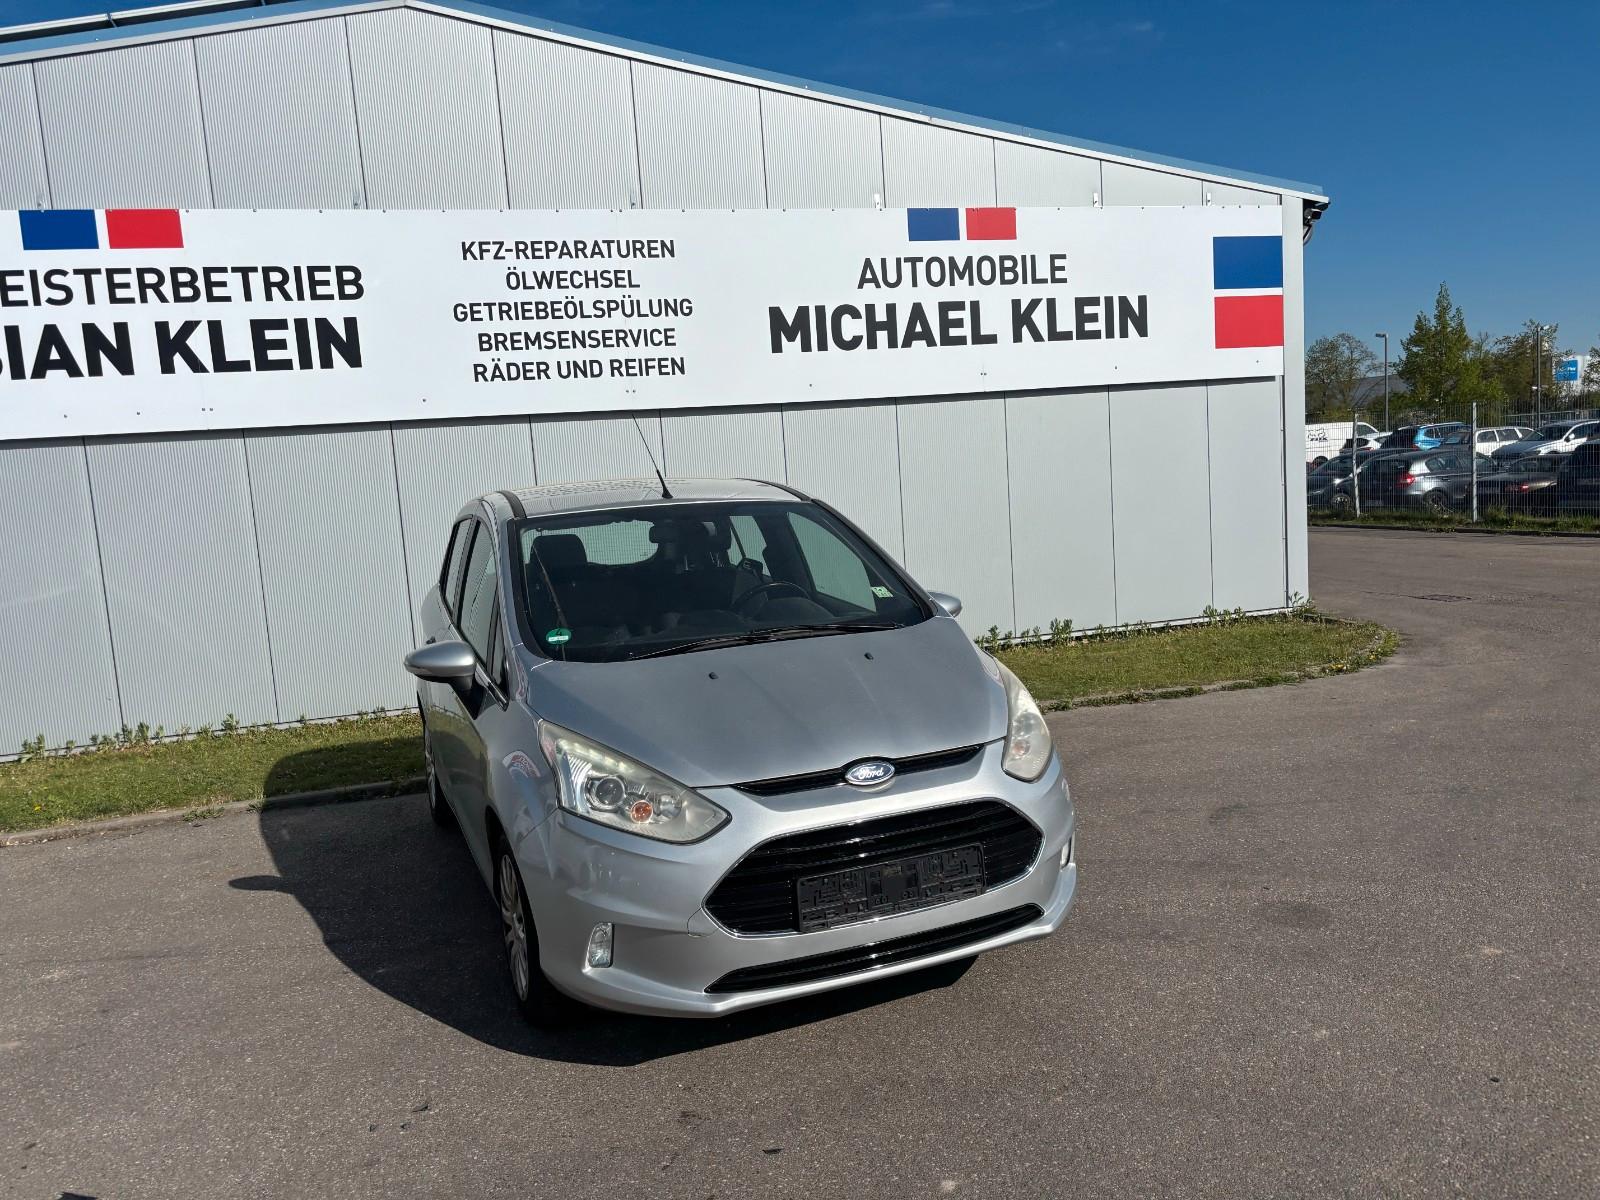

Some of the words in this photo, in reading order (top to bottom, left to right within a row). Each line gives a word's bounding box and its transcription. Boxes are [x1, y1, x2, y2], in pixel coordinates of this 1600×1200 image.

[461, 239, 675, 261] KFZ-REPARATUREN
[505, 266, 641, 291] ÖLWECHSEL
[857, 253, 1068, 290] AUTOMOBILE
[0, 265, 365, 308] EISTERBETRIEB
[453, 294, 693, 323] GETRIEBEÖLSPÜLUNG
[768, 300, 998, 354] MICHAEL
[1011, 294, 1149, 344] KLEIN
[0, 321, 135, 381] IAN
[154, 316, 363, 375] KLEIN
[477, 327, 677, 352] BREMSENSERVICE
[473, 357, 552, 383] RÄDER
[556, 359, 604, 380] UND
[609, 356, 686, 378] REIFEN
[857, 766, 884, 780] Ford
